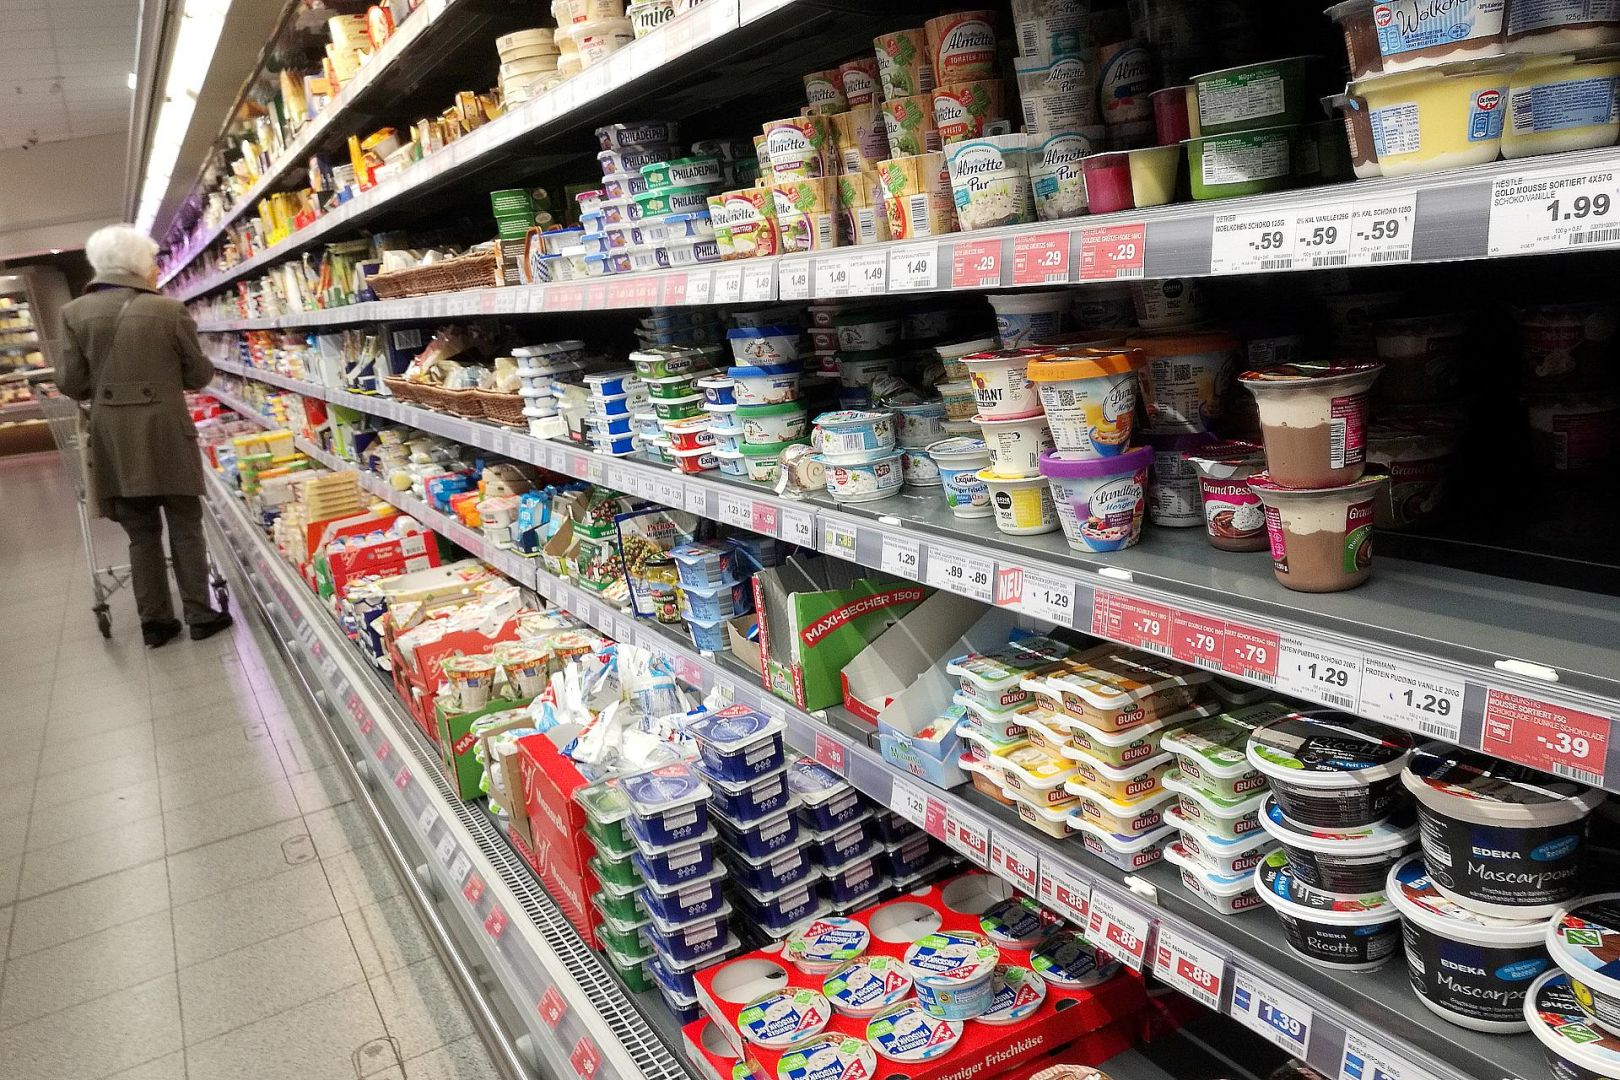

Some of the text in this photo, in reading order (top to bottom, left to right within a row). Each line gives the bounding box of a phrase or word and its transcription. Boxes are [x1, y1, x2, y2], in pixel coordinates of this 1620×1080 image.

[944, 32, 993, 53] Almette
[1049, 67, 1085, 83] Almette
[1059, 81, 1076, 93] Pur
[672, 163, 718, 181] PHILADELPHIA
[955, 157, 1003, 180] Almette
[1055, 165, 1079, 181] Pur
[967, 176, 990, 192] Pur
[1494, 173, 1613, 198] GOLD MOUSSE SORTIERT 4X57G
[1495, 178, 1523, 189] NESTLE
[1546, 193, 1611, 222] 1.99
[1299, 226, 1337, 246] -.59
[1356, 219, 1400, 240] -.59
[1249, 231, 1284, 250] -.59
[1037, 251, 1061, 267] -.29
[1108, 244, 1136, 261] -.29
[907, 259, 928, 275] 1.49
[973, 256, 995, 271] -.29
[791, 274, 806, 287] 1.49
[829, 270, 846, 283] 1.49
[864, 267, 882, 280] 1.49
[977, 388, 1003, 402] WANT
[1204, 482, 1252, 496] Grand Dess
[647, 522, 676, 532] PATROS
[796, 522, 809, 535] 1.29
[898, 552, 916, 566] 1.29
[945, 565, 988, 586] -.89 -.89
[999, 573, 1023, 600] NEU
[1043, 590, 1069, 608] 1.29
[805, 590, 921, 643] MAXI-BECHER 150g
[1133, 617, 1160, 636] -.79
[1185, 633, 1216, 652] -.79
[1234, 644, 1267, 664] -.79
[1366, 657, 1397, 671] EHRMANN
[1308, 663, 1349, 687] 1.29
[1365, 667, 1460, 698] PROTEIN PUDDING VANILLE 200G
[1002, 693, 1025, 704] BUKO
[1403, 688, 1451, 716] 1.29
[1066, 702, 1083, 715] BUKO
[1489, 698, 1567, 724] MOUSSE SORTIERT 75G
[1117, 709, 1144, 725] BUKO
[1488, 705, 1606, 742] SCHOKOLADE DUNKLE SCHOKOLADE
[1074, 736, 1090, 749] BUKO
[1536, 732, 1590, 758] -.39
[1124, 745, 1150, 761] BUKO
[1079, 769, 1095, 781] BUKO
[1182, 762, 1200, 778] BUKO
[1006, 776, 1020, 789] BUKO
[1128, 779, 1154, 795] BUKO
[1236, 777, 1264, 792] BUKO
[907, 797, 923, 813] 1.29
[1083, 803, 1100, 817] BUKO
[1182, 801, 1200, 817] BUKO
[1020, 807, 1036, 820] BUKO
[1134, 815, 1159, 830] BUKO
[964, 834, 981, 849] -.88
[1085, 839, 1102, 852] BUKO
[1183, 836, 1200, 853] BUKO
[1135, 851, 1161, 866] BUKO
[1472, 846, 1522, 860] EDEKA
[1011, 863, 1030, 880] -.88
[1467, 860, 1578, 889] Mascarpone
[1183, 874, 1200, 890] BUKO
[1062, 892, 1083, 910] -.88
[1112, 930, 1137, 950] -.88
[1316, 930, 1347, 939] EDEKA
[1307, 936, 1358, 954] Ricotta
[1440, 958, 1487, 977] EDEKA
[1184, 965, 1212, 987] -.88
[1437, 971, 1526, 1007] Mascarpo
[1264, 1004, 1301, 1036] 1.39
[985, 1033, 1044, 1068] Frischkäse
